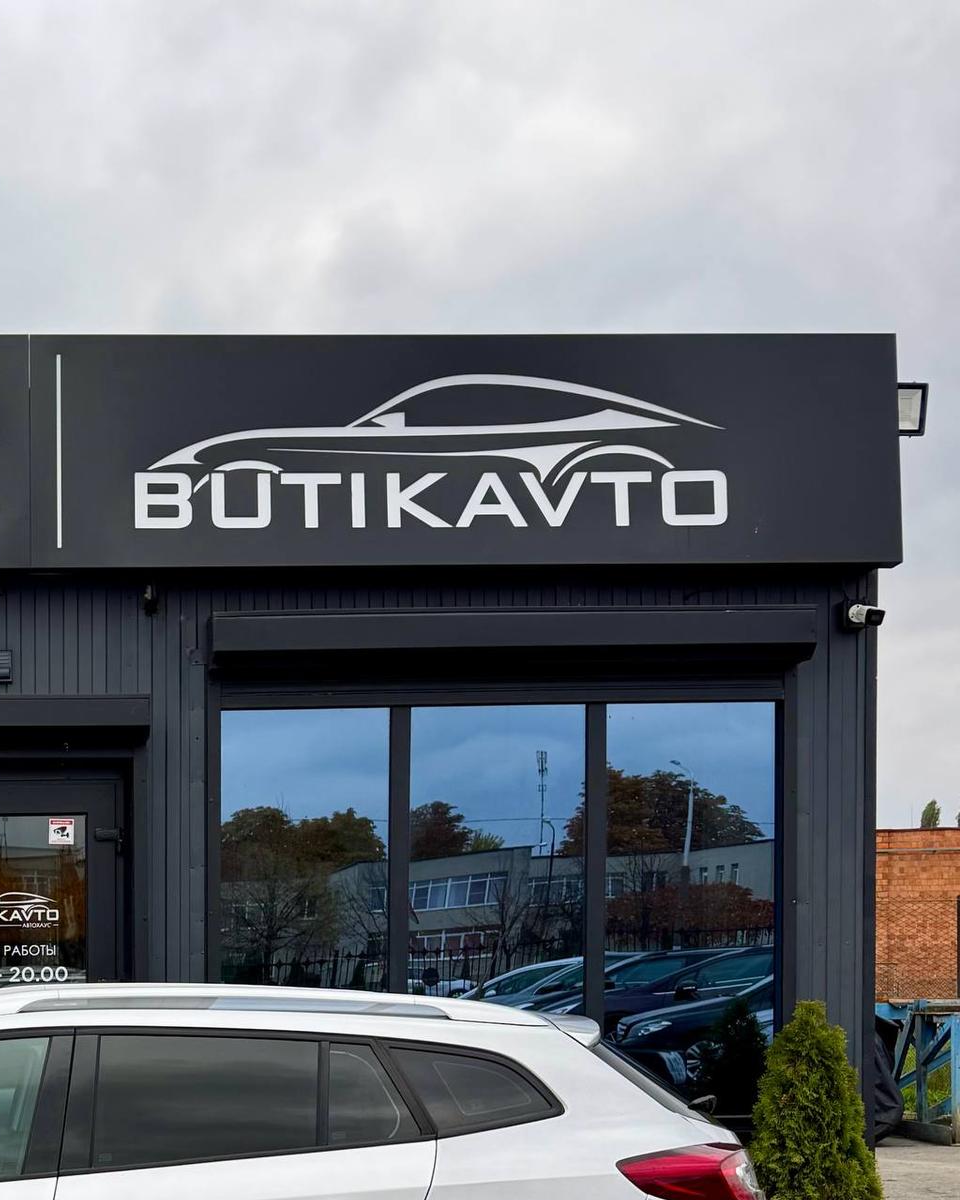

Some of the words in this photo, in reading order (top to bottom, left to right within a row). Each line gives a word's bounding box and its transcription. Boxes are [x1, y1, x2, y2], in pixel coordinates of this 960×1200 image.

[134, 470, 729, 530] BUTIKAVTO
[3, 944, 56, 957] РАБОТЫ
[8, 966, 69, 983] 20.00
